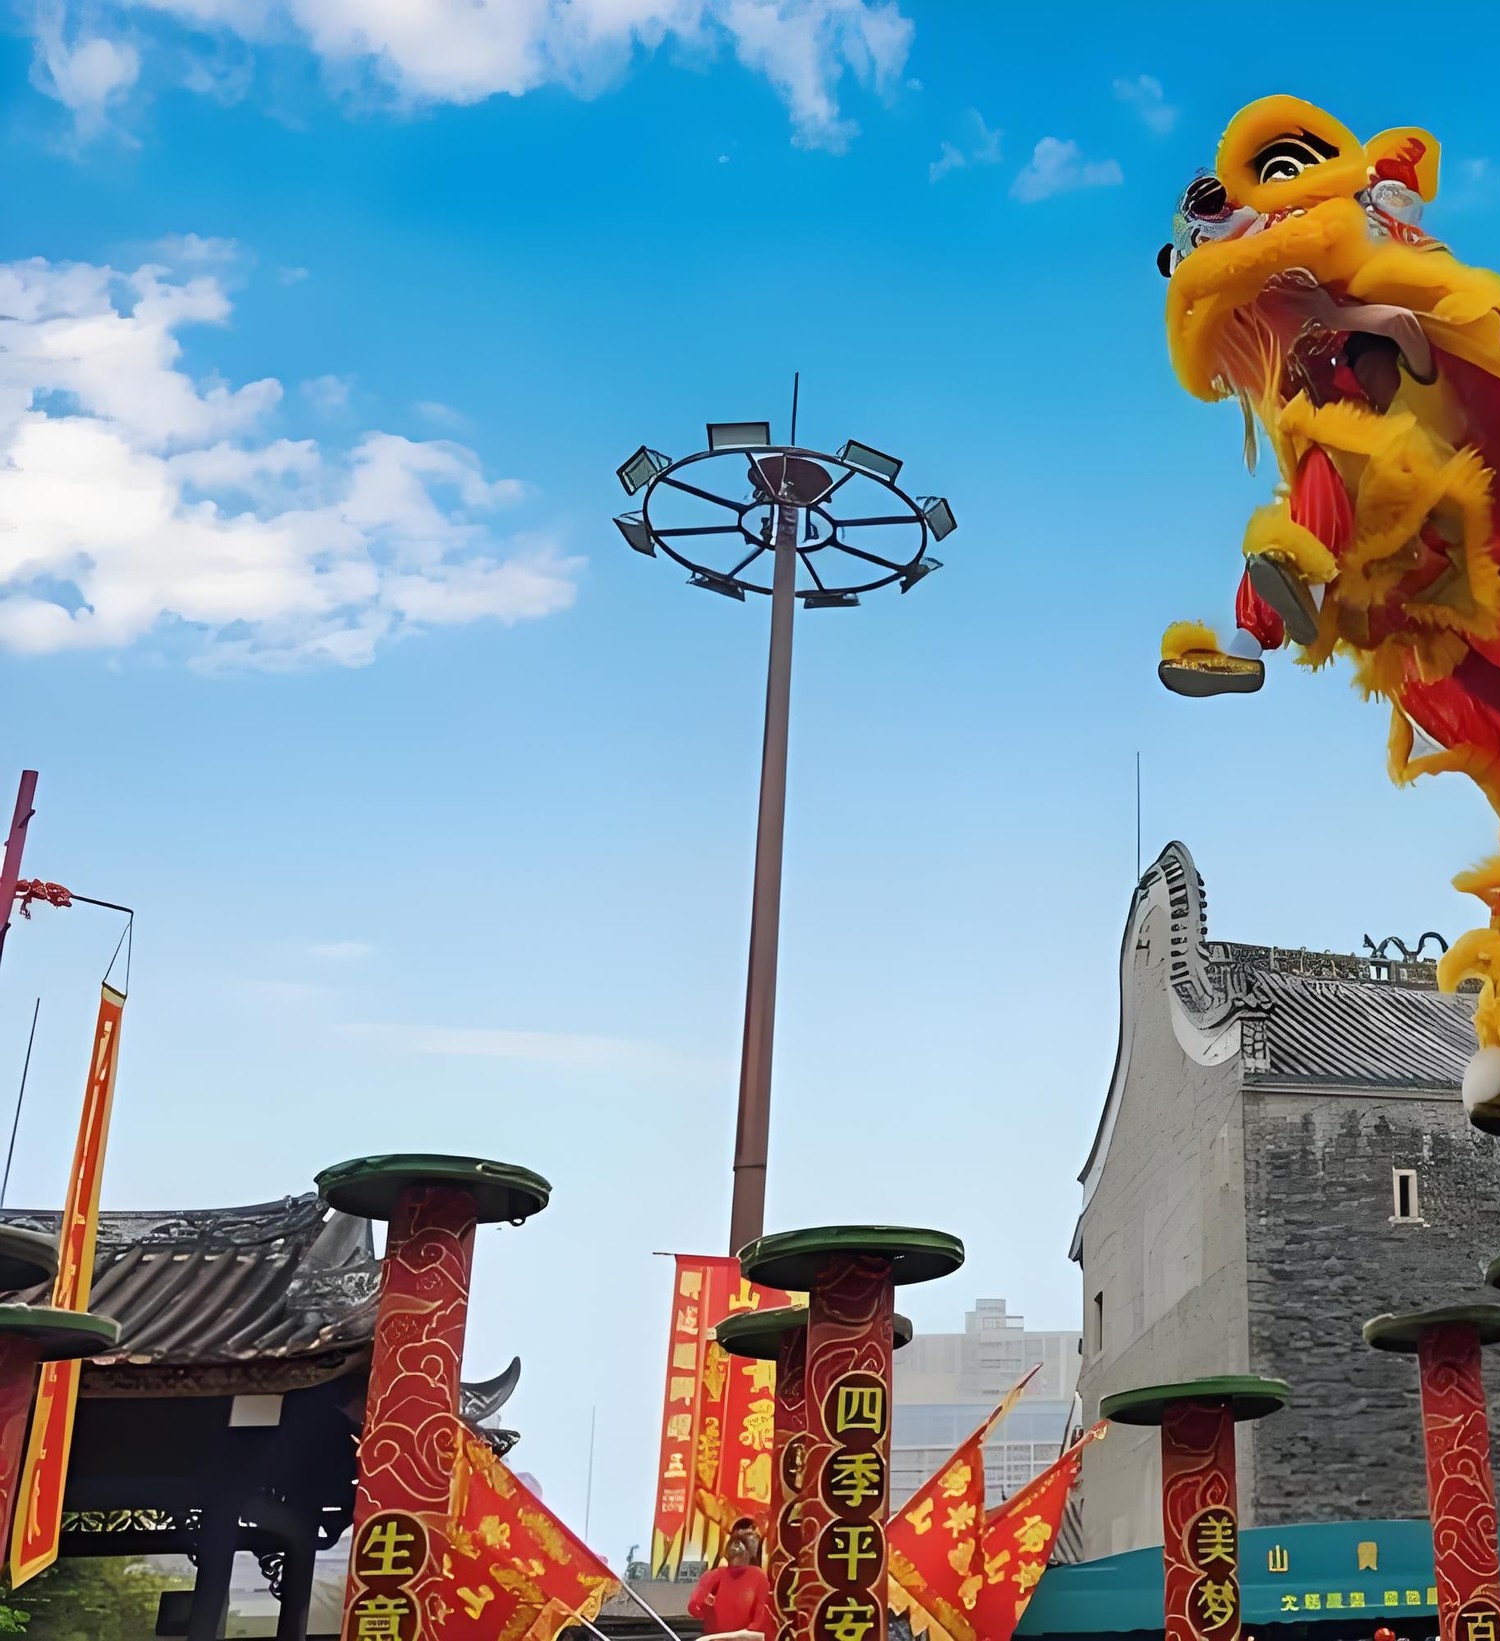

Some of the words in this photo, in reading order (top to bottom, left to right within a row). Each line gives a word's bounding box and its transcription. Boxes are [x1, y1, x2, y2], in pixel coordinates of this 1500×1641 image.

[824, 1386, 883, 1641] 四季平安
[1197, 1515, 1236, 1632] 美梦
